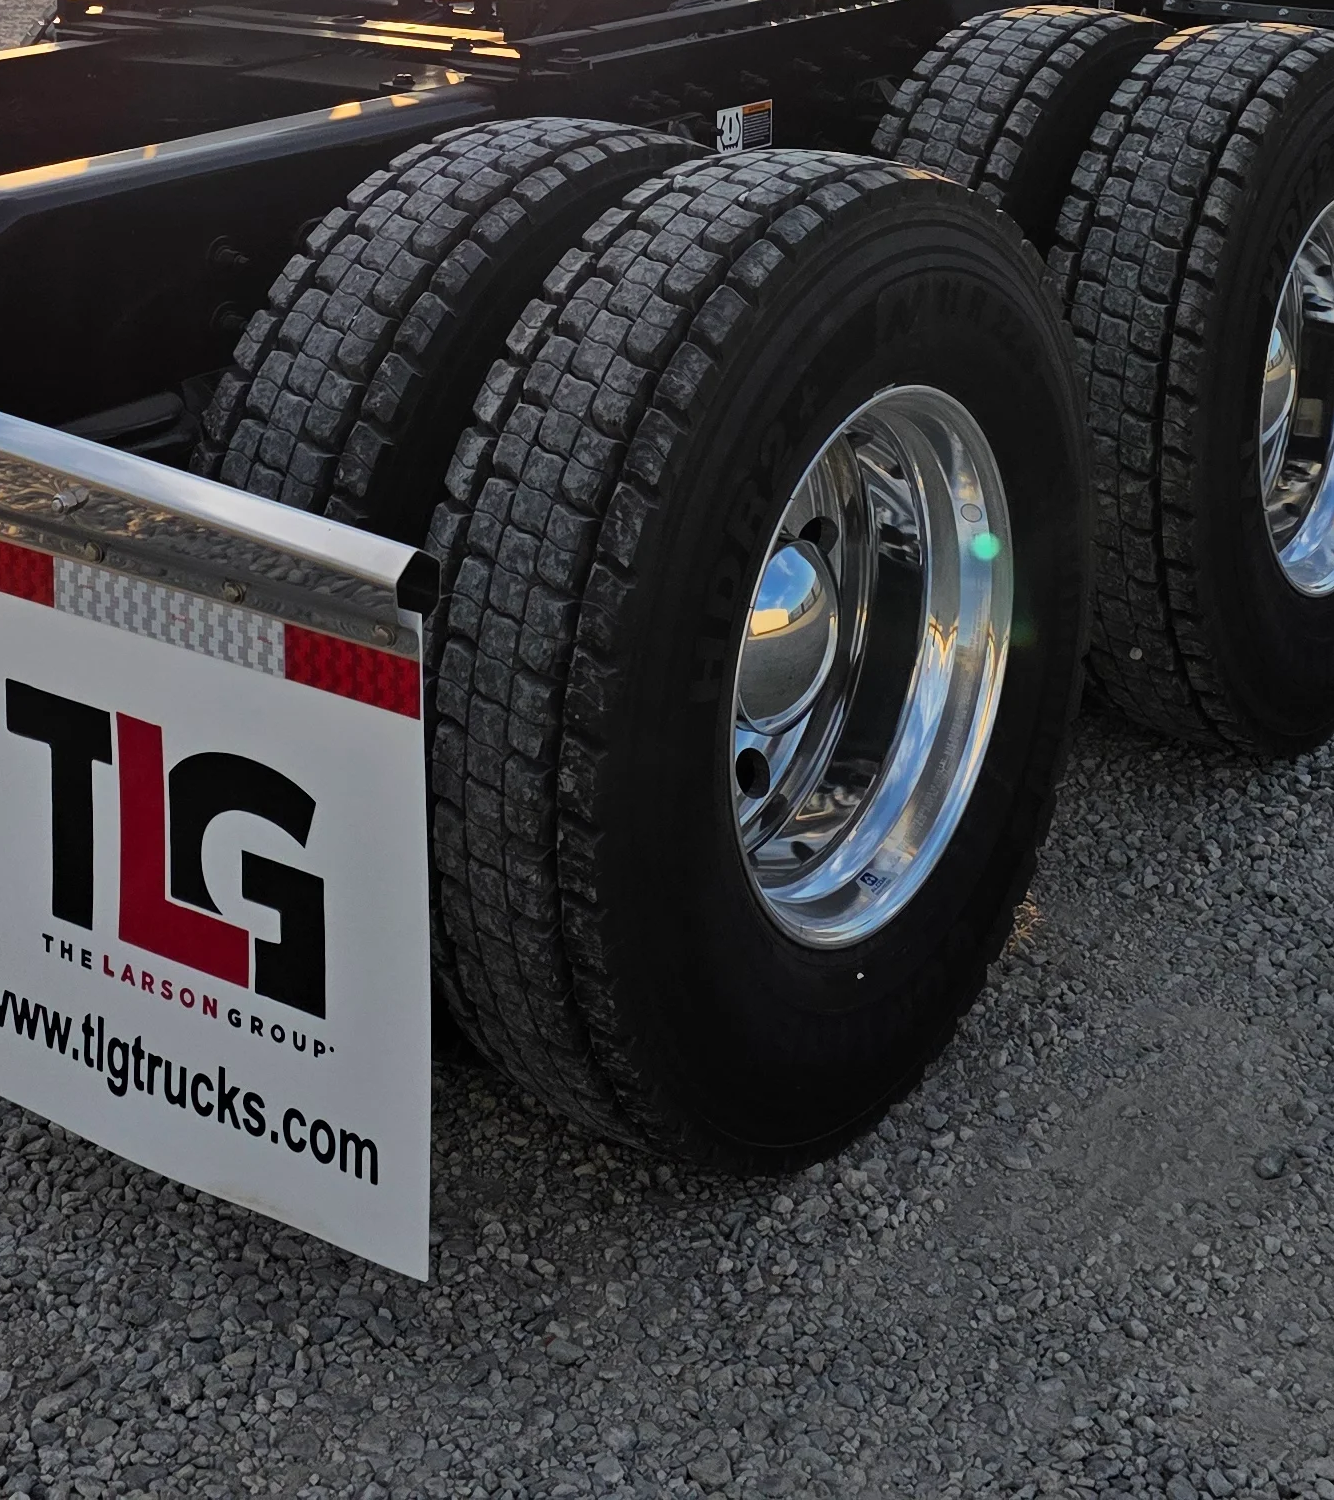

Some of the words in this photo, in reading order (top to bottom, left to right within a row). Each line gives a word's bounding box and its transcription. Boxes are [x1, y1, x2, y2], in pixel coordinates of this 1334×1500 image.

[5, 677, 327, 1021] TLG
[41, 932, 93, 971] THE
[103, 954, 218, 1020] LARSON
[227, 1008, 327, 1059] GROUP
